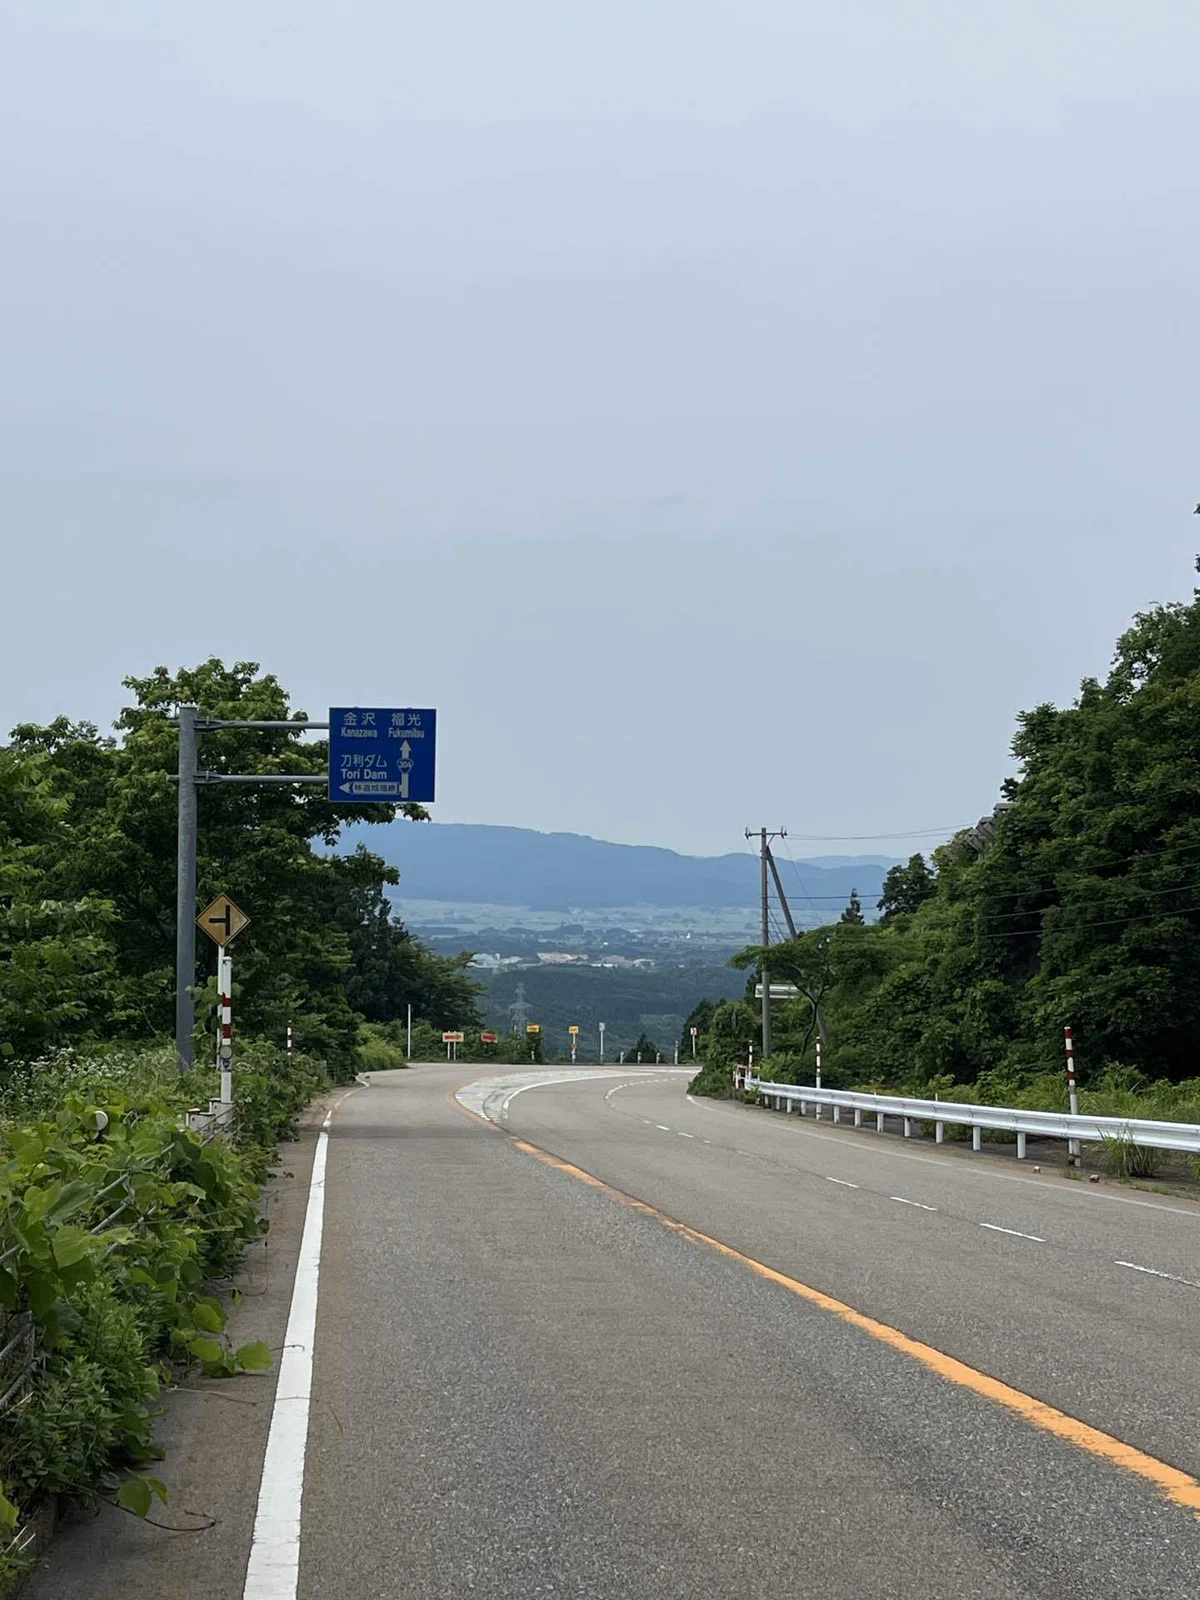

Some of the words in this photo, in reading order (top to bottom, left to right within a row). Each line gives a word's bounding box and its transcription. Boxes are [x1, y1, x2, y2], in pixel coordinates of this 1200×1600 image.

[343, 711, 376, 726] 金沢
[391, 712, 421, 727] 福光
[341, 726, 378, 738] Kanazawa
[340, 754, 387, 767] 刀利ダム
[340, 768, 360, 779] Tori
[363, 768, 387, 780] Dam
